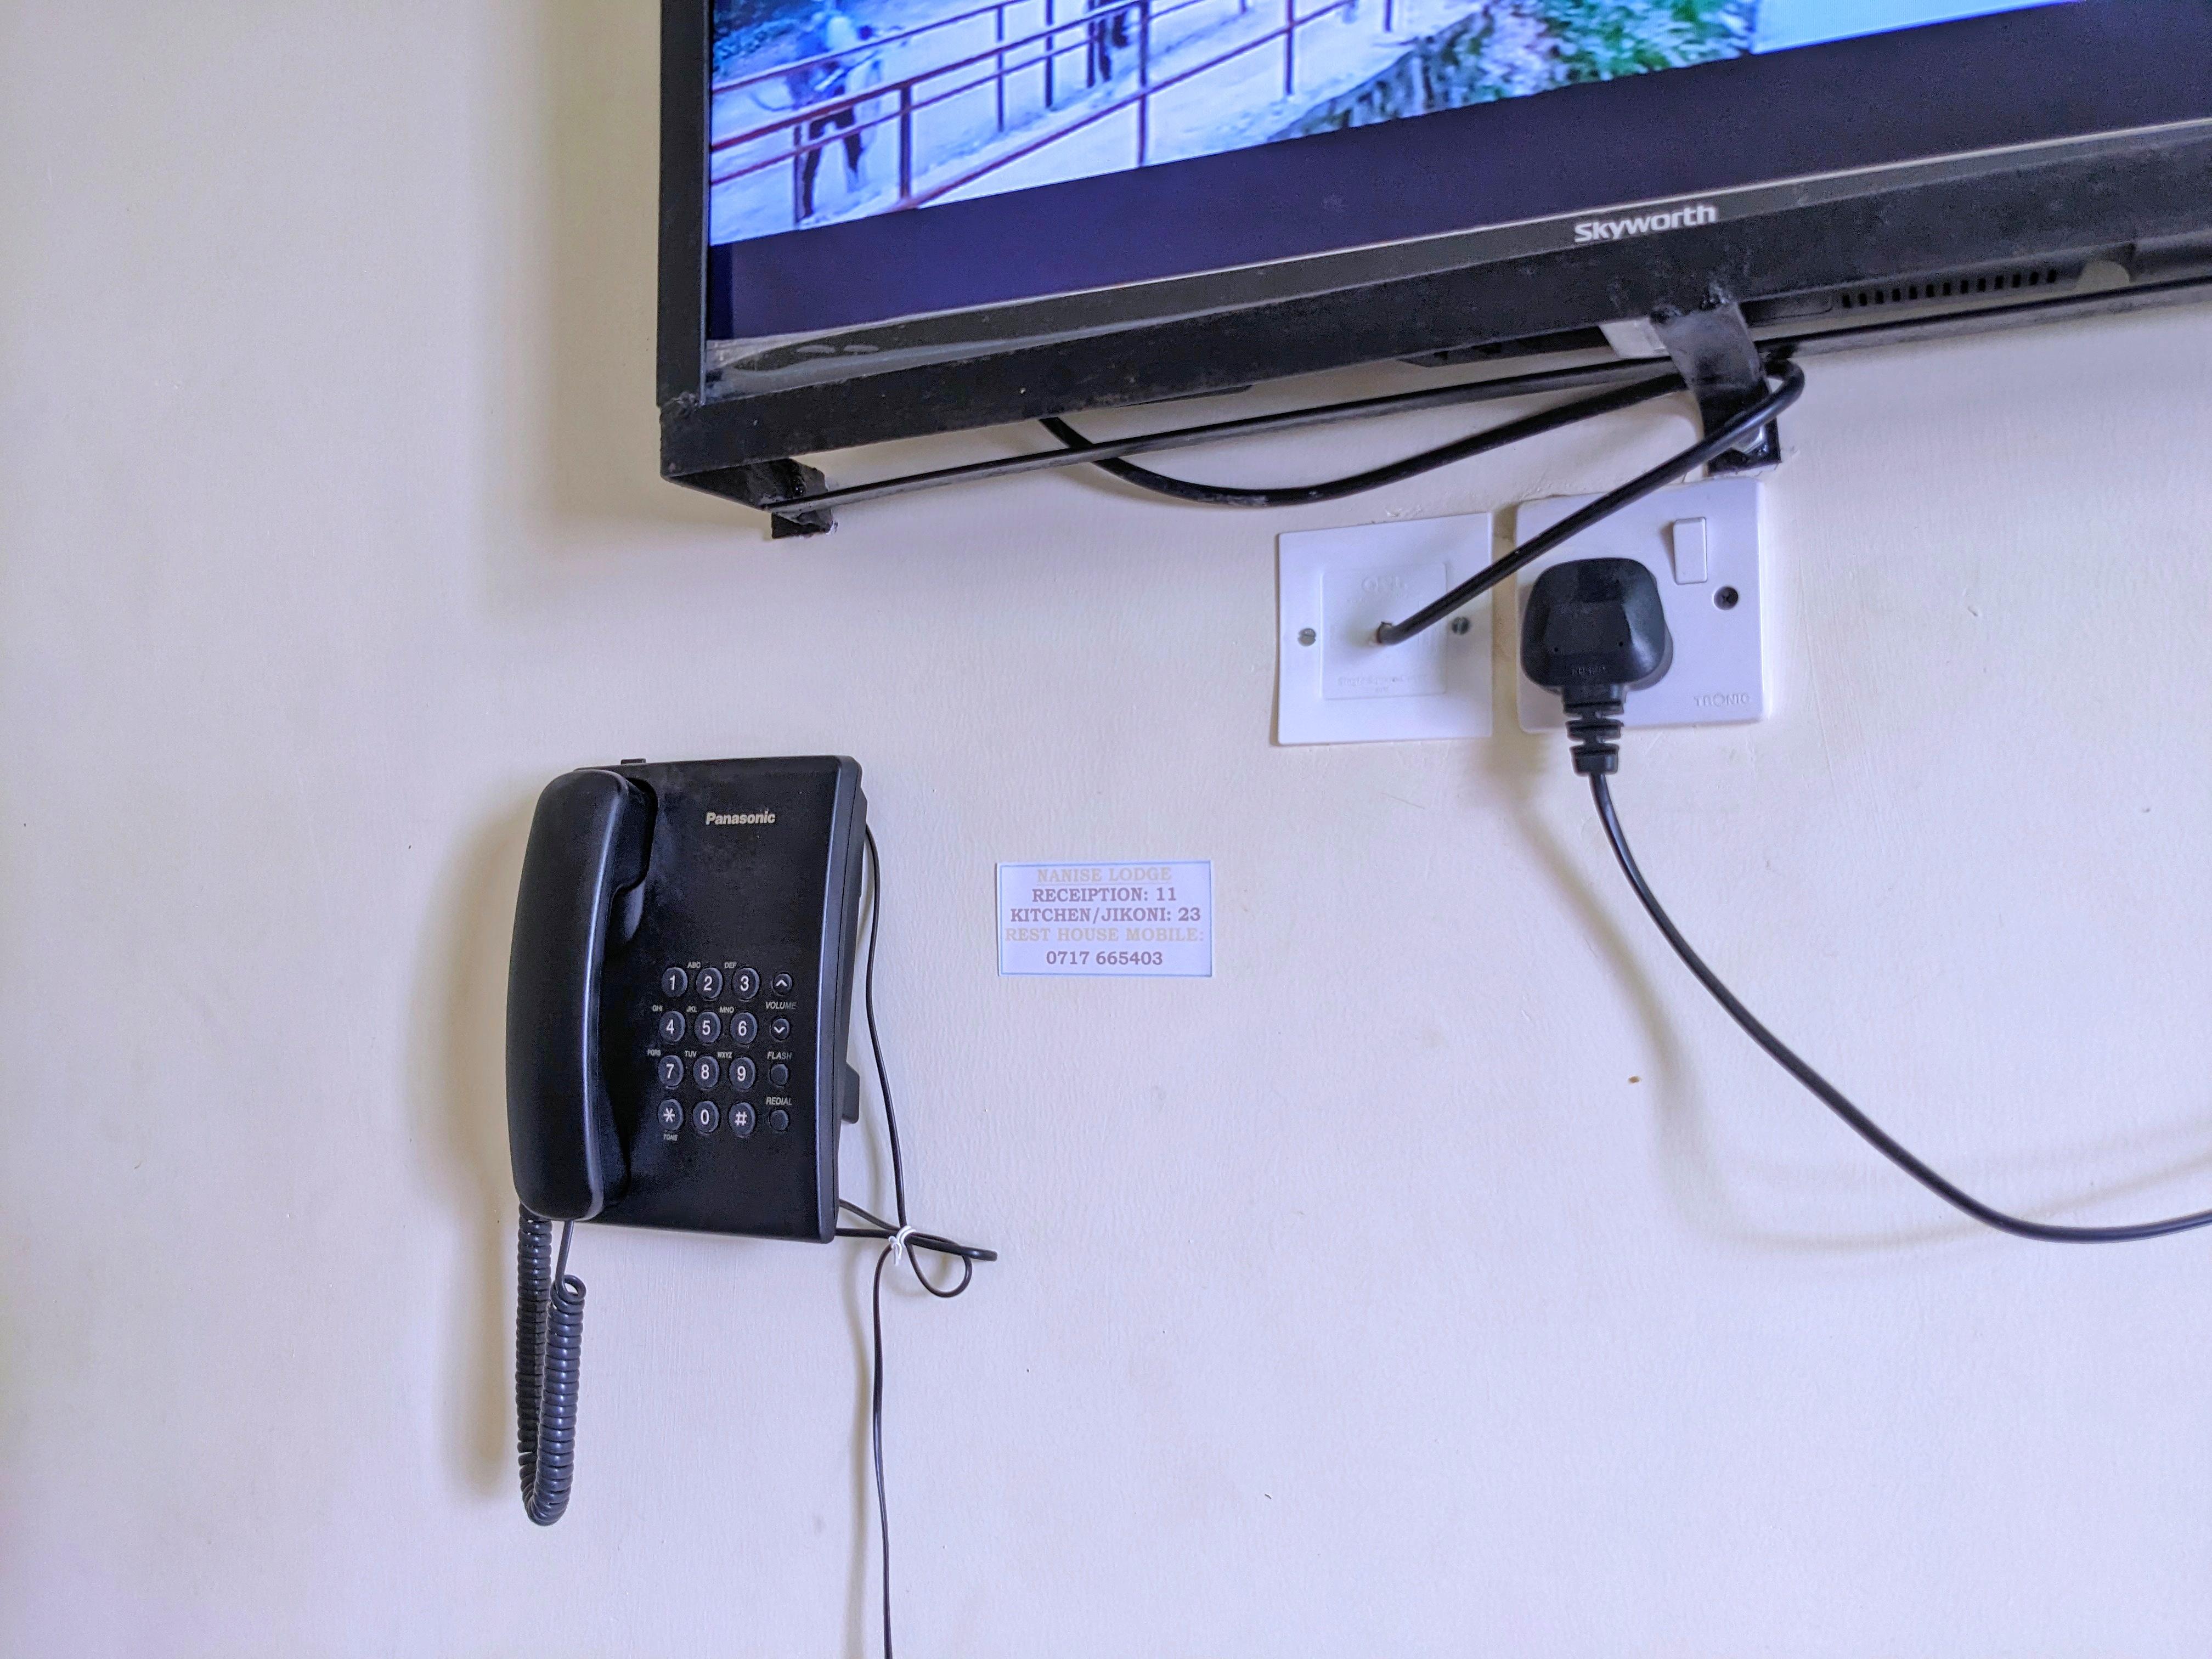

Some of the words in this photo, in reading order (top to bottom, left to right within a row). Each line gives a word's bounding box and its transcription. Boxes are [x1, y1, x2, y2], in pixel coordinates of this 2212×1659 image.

[1574, 205, 1717, 242] Skyworth
[706, 809, 776, 825] Panasonic
[1036, 868, 1102, 883] NANISE
[1108, 867, 1172, 882] LODGE
[1032, 887, 1148, 902] RECEIPTION:
[1156, 887, 1176, 901] 11
[1010, 907, 1171, 924] KITCHEN/JIKONI:
[1178, 907, 1201, 922] 23
[1004, 928, 1049, 941] REST
[1057, 928, 1119, 941] HOUSE
[1125, 927, 1204, 941] MOBILE:
[1046, 951, 1090, 965] 0717
[1096, 950, 1163, 965] 665403
[669, 975, 675, 990] 1
[703, 975, 713, 991] 2
[741, 975, 749, 991] 3
[765, 1001, 797, 1010] VOLUME
[666, 1019, 675, 1034] 4
[702, 1020, 711, 1035] 5
[738, 1020, 747, 1036] 6
[767, 1051, 792, 1060] FLASH
[666, 1063, 674, 1079] 7
[701, 1064, 710, 1079] 8
[737, 1065, 746, 1081] 9
[766, 1097, 792, 1105] REDIAL
[701, 1109, 709, 1125] 0
[735, 1111, 748, 1126] #
